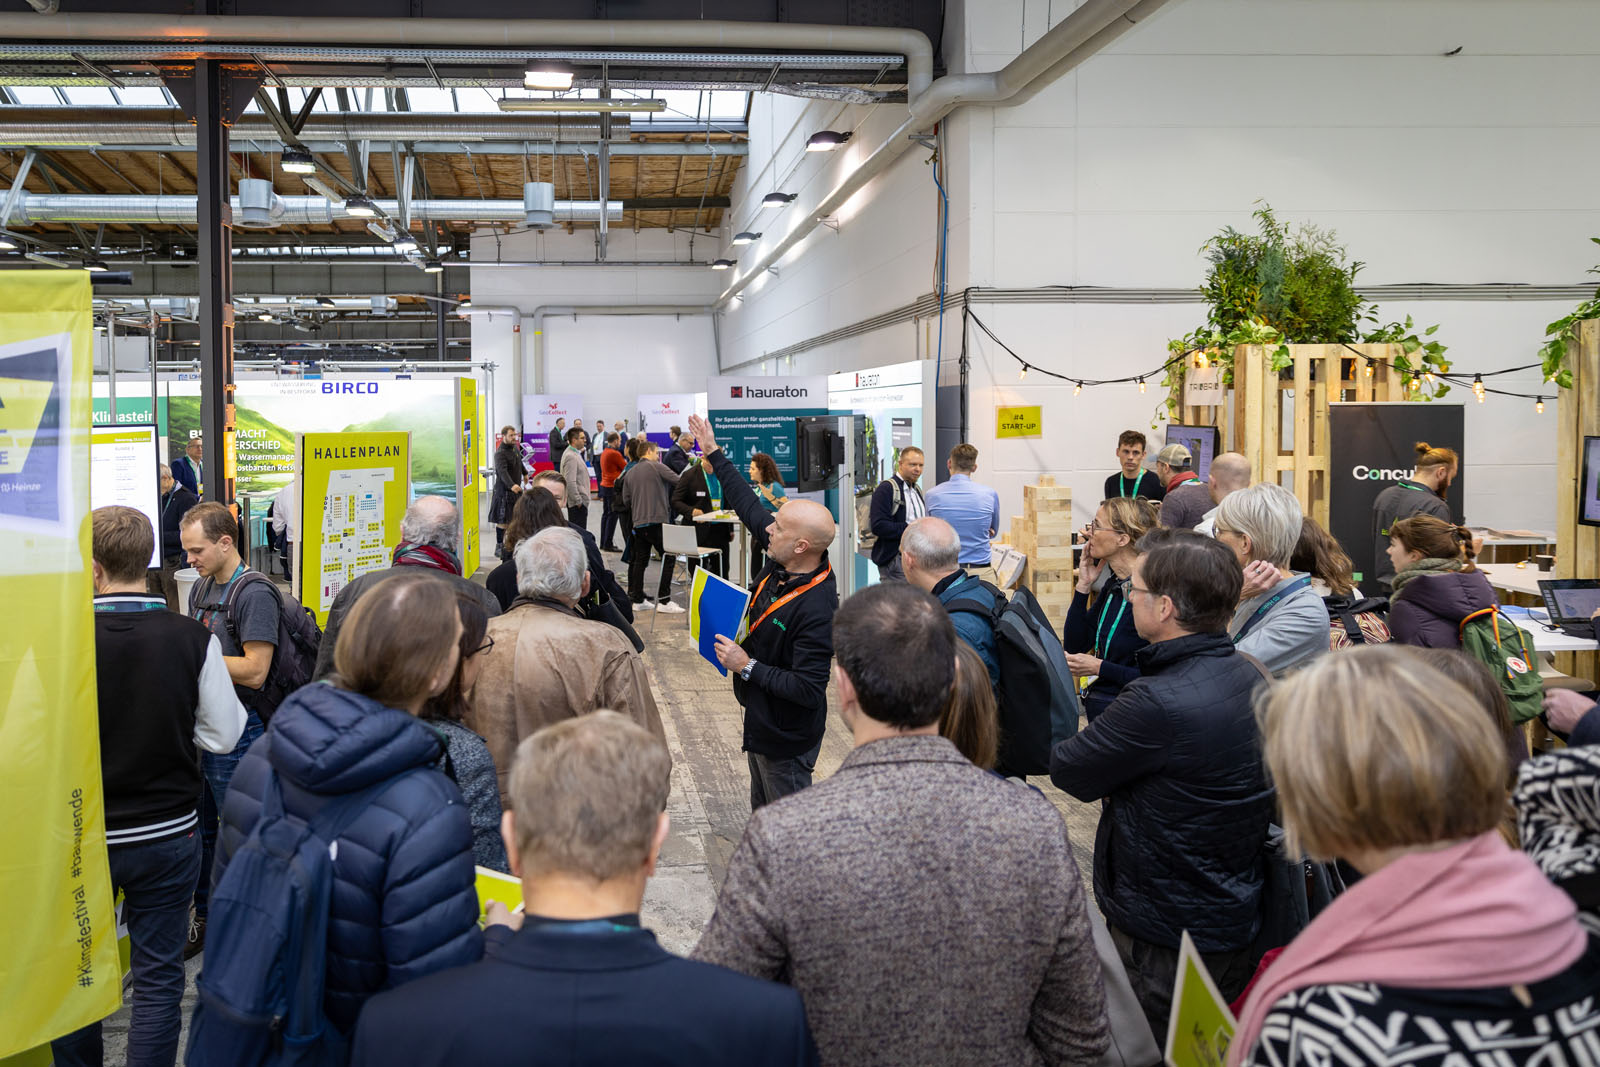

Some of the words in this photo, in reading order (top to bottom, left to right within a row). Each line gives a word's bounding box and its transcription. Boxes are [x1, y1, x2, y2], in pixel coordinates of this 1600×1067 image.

[322, 382, 379, 394] BIRCO
[746, 385, 808, 398] hauraton
[1013, 413, 1024, 421] #4
[314, 445, 400, 459] HALLENPLAN
[11, 483, 41, 491] Heinze
[68, 787, 84, 879] #bauwende
[72, 884, 94, 988] #klimafestival
